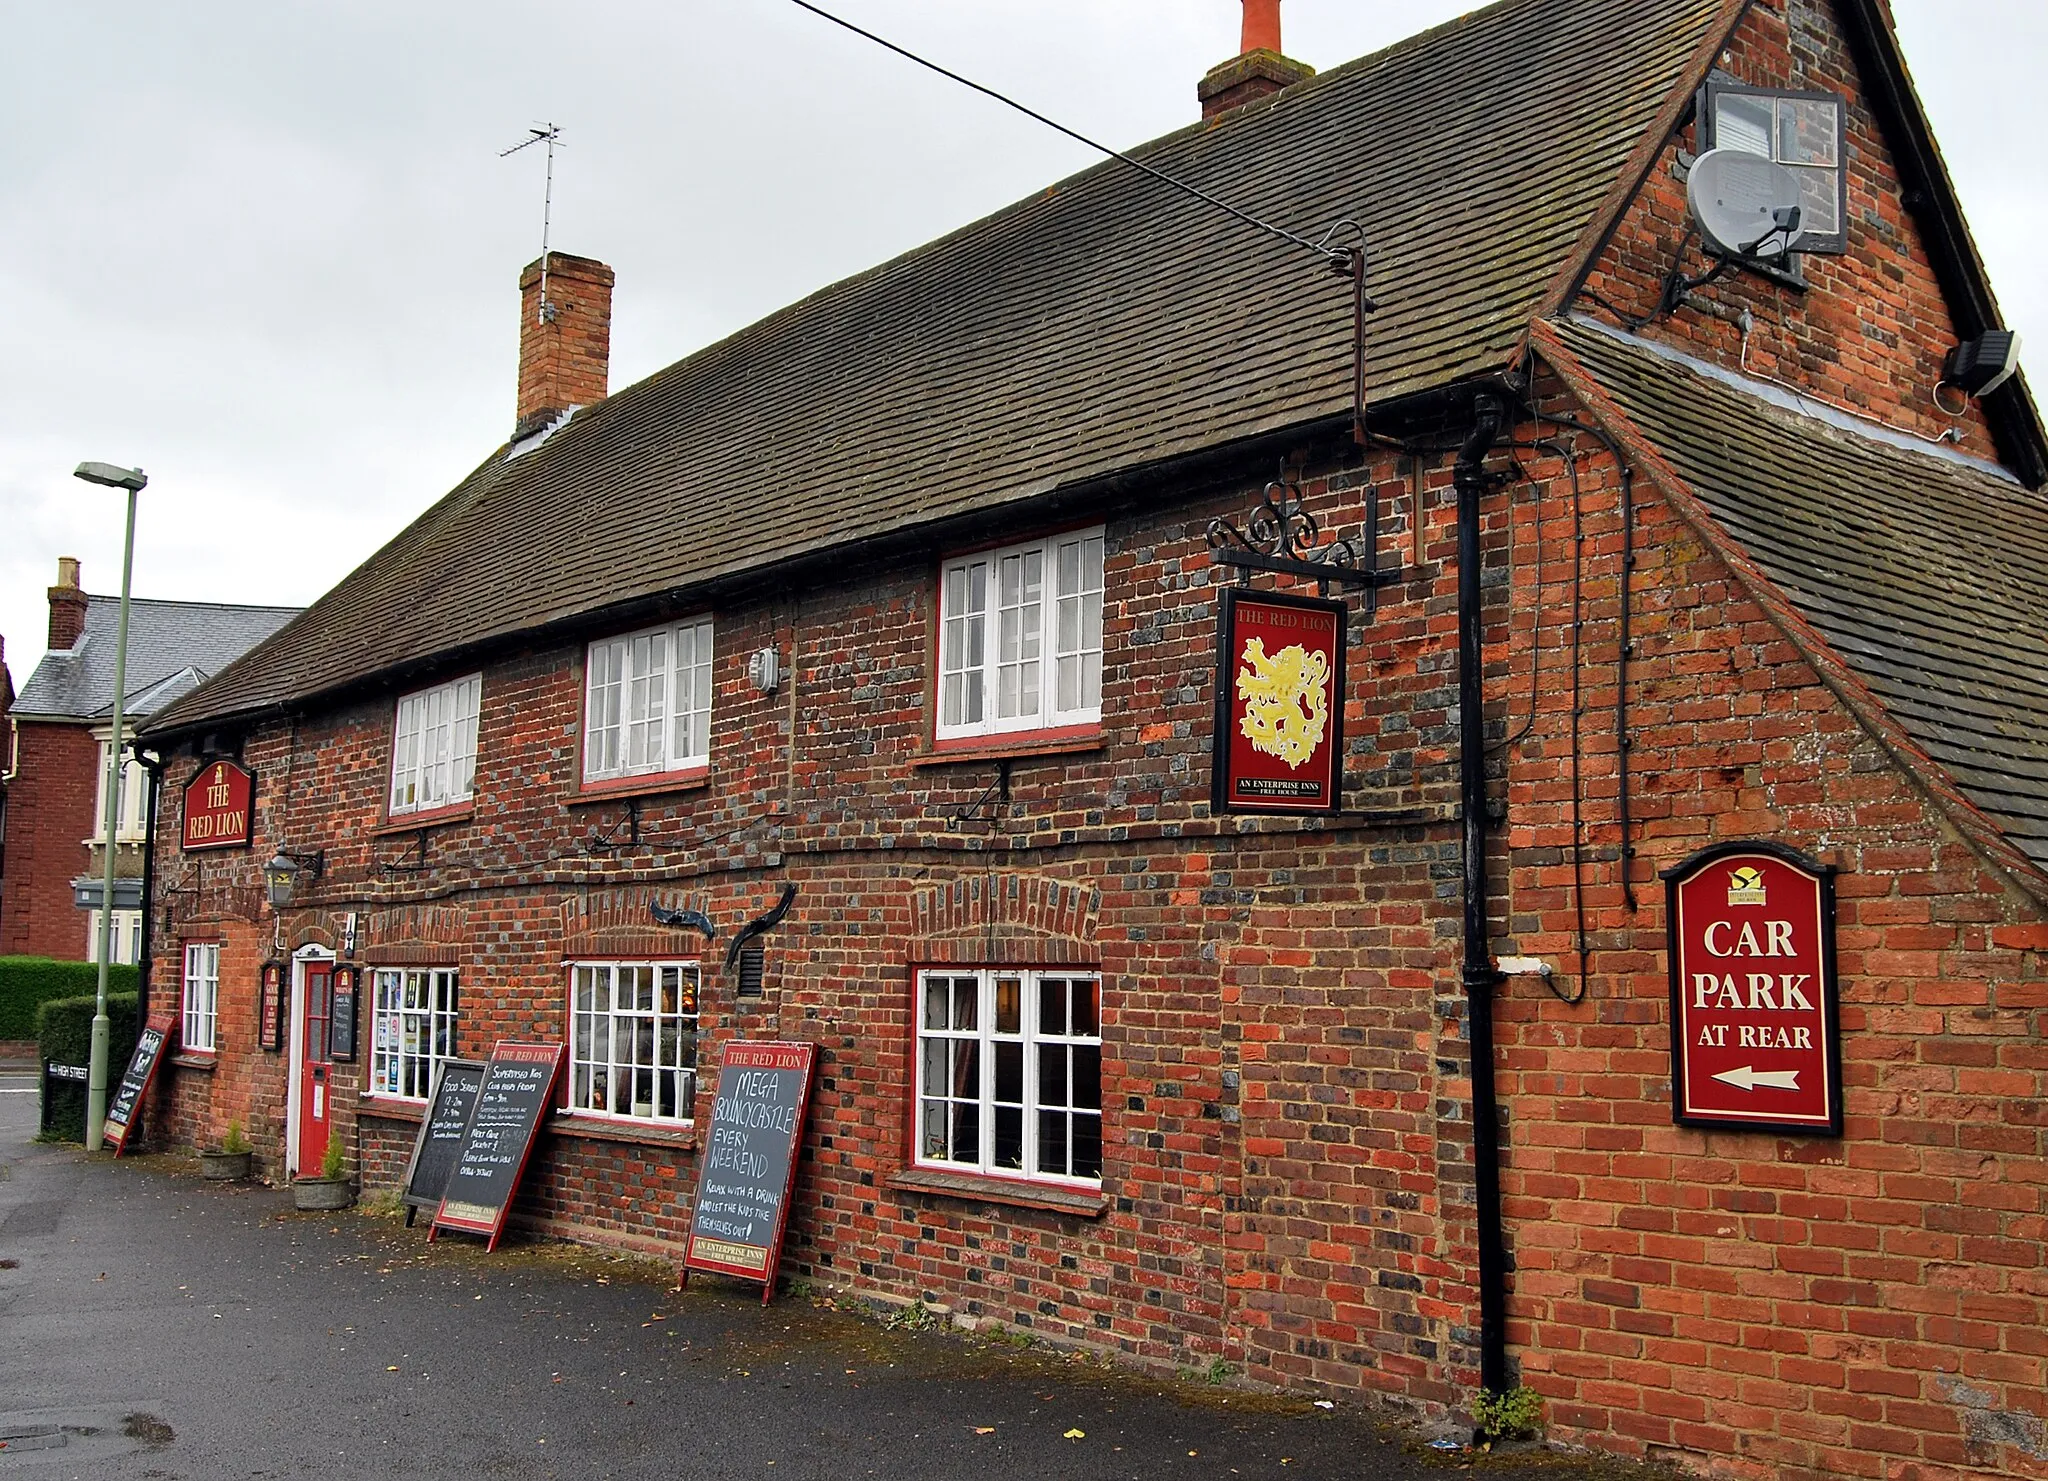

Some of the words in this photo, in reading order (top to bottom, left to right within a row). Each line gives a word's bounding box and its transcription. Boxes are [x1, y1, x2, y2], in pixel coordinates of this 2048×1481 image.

[1237, 608, 1264, 624] THE
[1270, 612, 1297, 627] RED
[1303, 616, 1332, 632] LION
[207, 784, 230, 808] THE
[1253, 780, 1299, 789] ENTERPRISE
[1301, 782, 1319, 790] INNS
[189, 815, 213, 839] RED
[215, 811, 244, 837] LION
[1704, 920, 1797, 957] CAR
[1692, 973, 1815, 1010] PARK
[1698, 1025, 1729, 1046] AT
[1738, 1025, 1813, 1049] REAR
[500, 1050, 514, 1060] THE
[515, 1051, 532, 1061] RED
[533, 1051, 553, 1062] LION
[728, 1052, 749, 1065] THE
[751, 1053, 773, 1066] RED
[776, 1055, 802, 1068] LION
[57, 1064, 69, 1077] HIGH
[70, 1066, 88, 1079] STREET
[735, 1071, 779, 1100] MEGA
[714, 1128, 749, 1151] EVERY
[710, 1147, 769, 1179] WEEKEND
[705, 1179, 726, 1195] RELAX
[727, 1184, 745, 1197] WITH
[747, 1187, 754, 1199] A
[755, 1188, 779, 1206] DRINK
[724, 1203, 736, 1213] THE
[737, 1203, 753, 1218] KIDS
[698, 1216, 732, 1236] THEMSELVES
[697, 1240, 706, 1250] AN
[707, 1243, 745, 1257] ENTERPRISE
[747, 1249, 763, 1260] INNS
